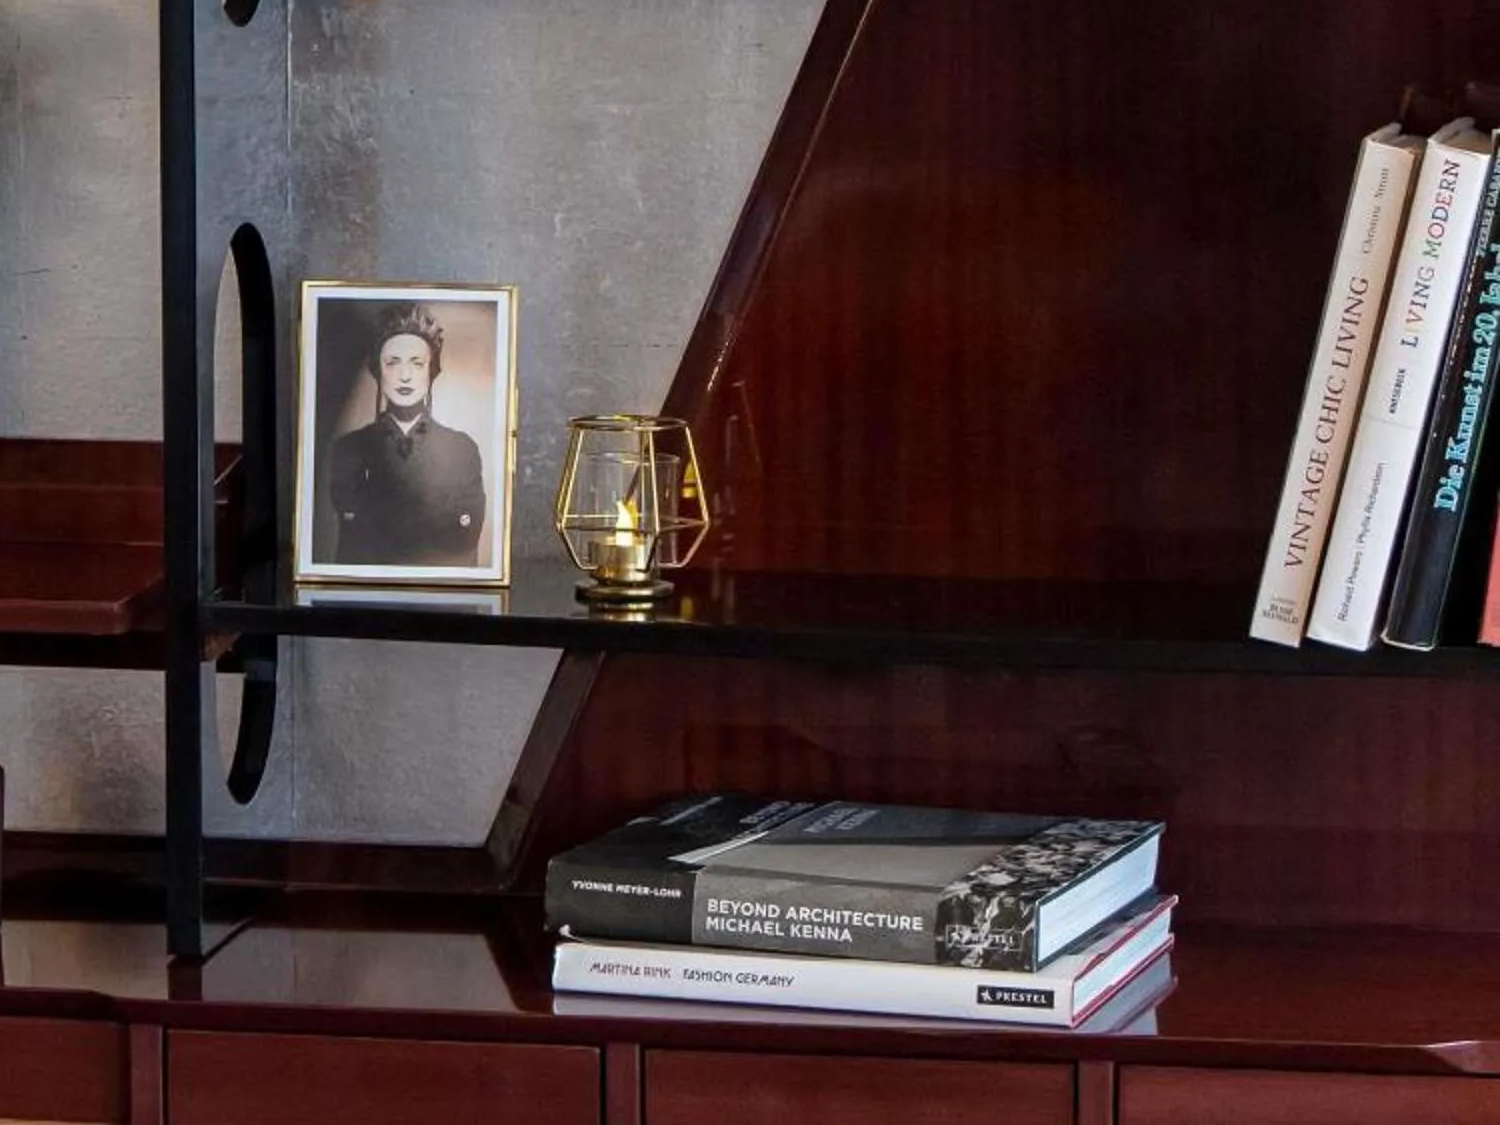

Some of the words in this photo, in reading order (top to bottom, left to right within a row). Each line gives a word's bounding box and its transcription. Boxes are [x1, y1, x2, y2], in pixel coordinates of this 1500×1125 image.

[1401, 266, 1435, 348] LIVING
[1422, 159, 1460, 259] MODERN
[1331, 276, 1369, 369] LIVING
[1463, 351, 1490, 384] im
[1315, 376, 1350, 444] CHIC
[1444, 383, 1483, 462] Kunst
[1433, 464, 1466, 513] Die
[1284, 451, 1329, 569] VINTAGE
[571, 879, 613, 893] YVONNE
[615, 883, 683, 899] MEYER-LOHR
[705, 916, 785, 937] MICHAEL
[789, 924, 853, 943] KENNA
[707, 898, 781, 919] BEYOND
[785, 905, 924, 932] ARCHITECTURE
[683, 968, 733, 983] FASHION
[735, 972, 795, 988] GERMANY
[995, 991, 1048, 1004] PRESTEL
